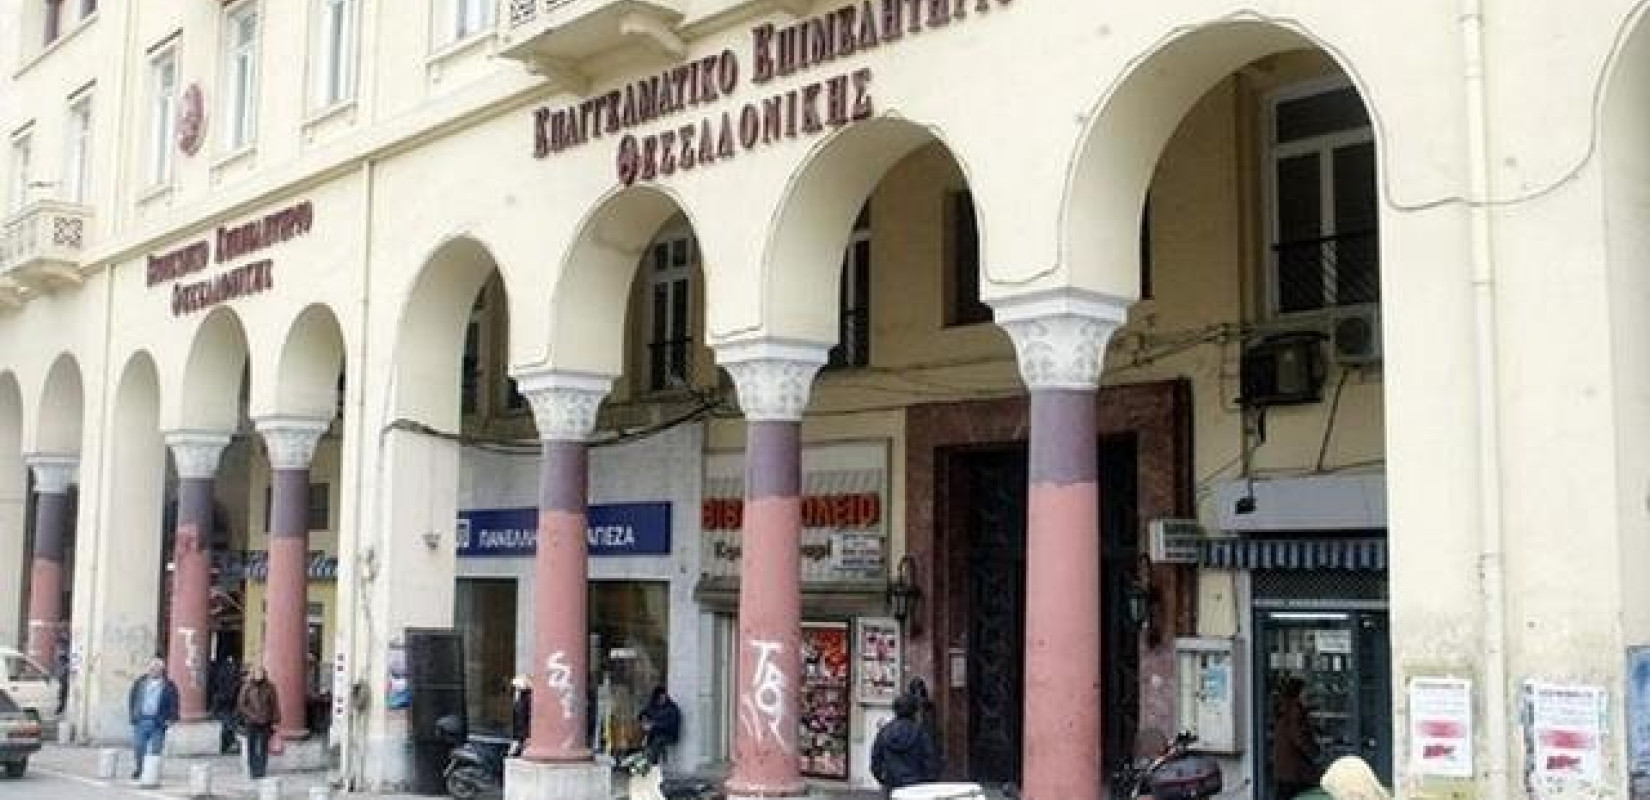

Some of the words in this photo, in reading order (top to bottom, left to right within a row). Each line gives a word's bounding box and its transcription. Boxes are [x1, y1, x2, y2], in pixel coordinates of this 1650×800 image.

[533, 49, 738, 159] ΕΠΑΓΓΕΛΜΑΤΙΚΟ
[751, 0, 1012, 84] ΕΠΙΜΕΛΗΤΗ
[617, 67, 873, 186] ΘΕΣΣΑΛΟΝΙΚΗΣ
[588, 525, 635, 547] ΑΠΕΖΑ
